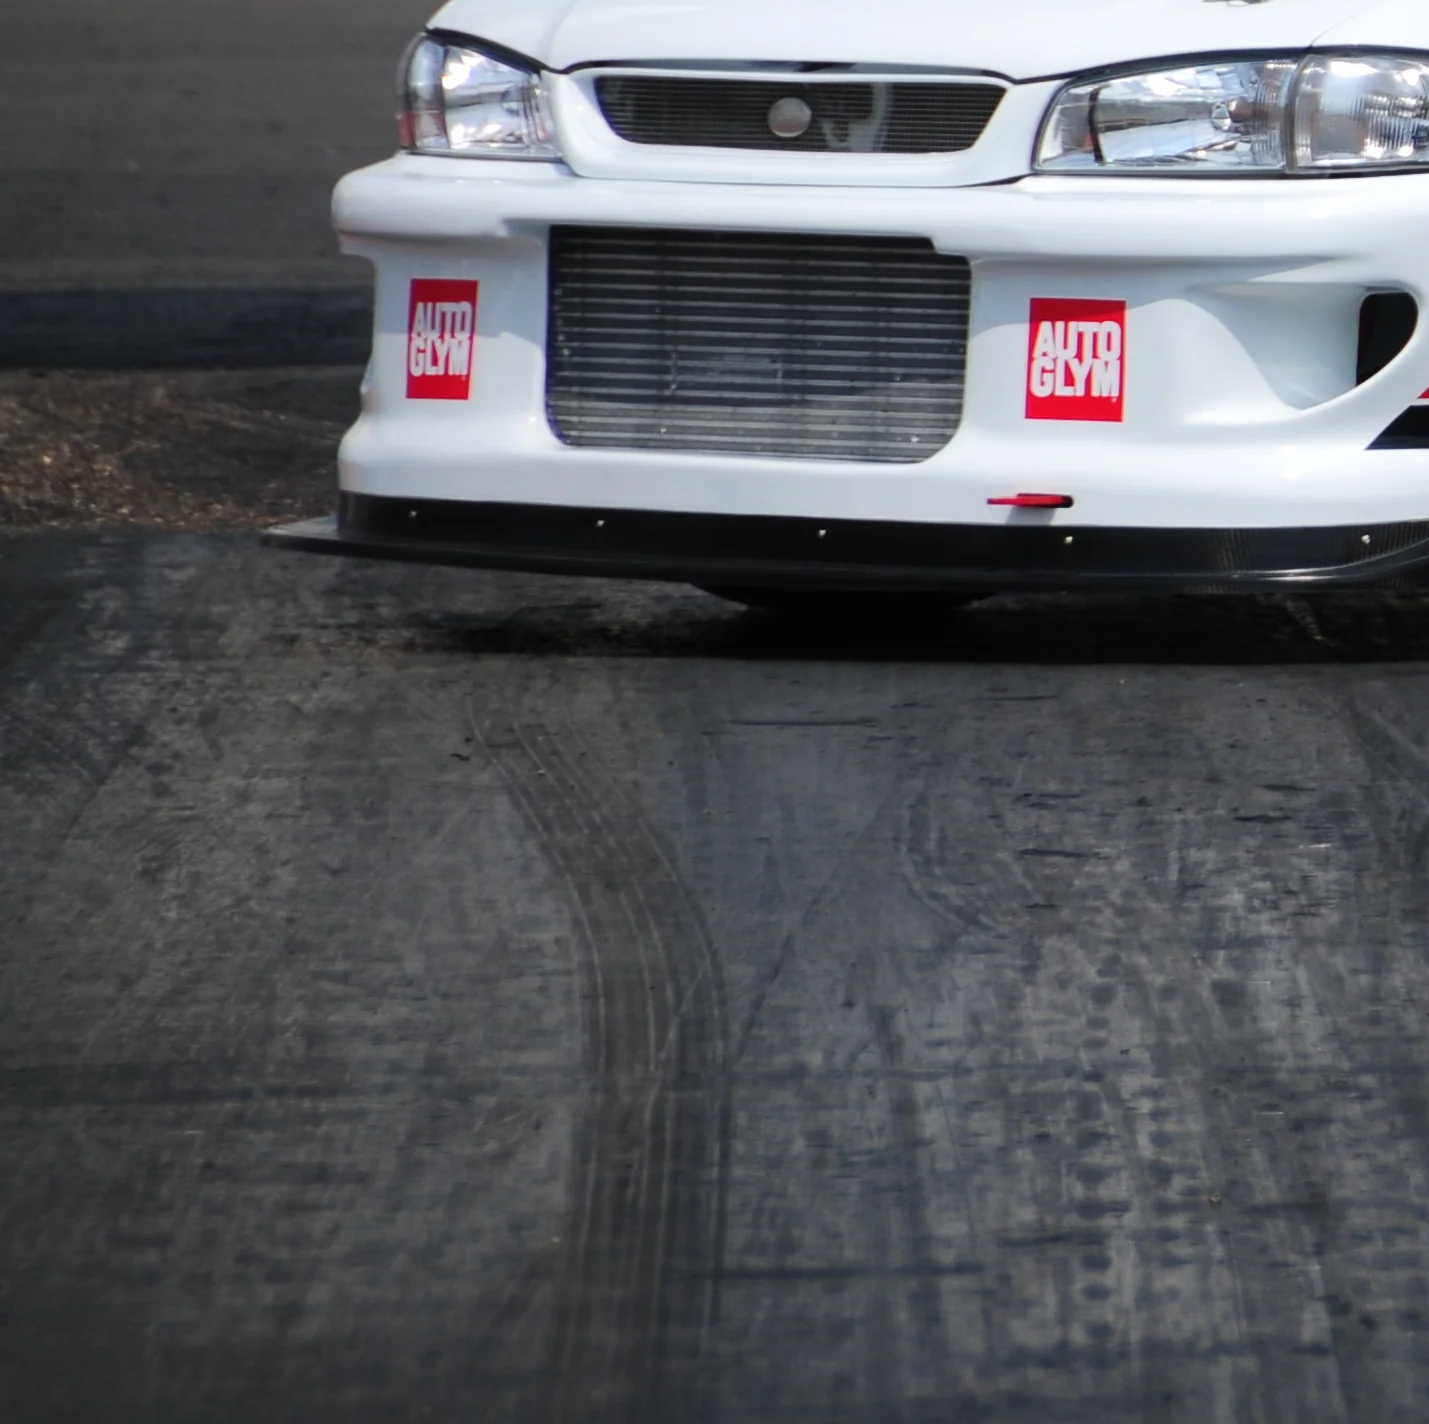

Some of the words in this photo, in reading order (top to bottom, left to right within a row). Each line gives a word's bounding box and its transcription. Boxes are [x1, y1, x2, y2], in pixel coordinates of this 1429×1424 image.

[412, 301, 472, 338] AUTO
[1032, 320, 1122, 359] AUTO
[410, 336, 471, 377] GLYM
[1029, 357, 1121, 398] GLYM
